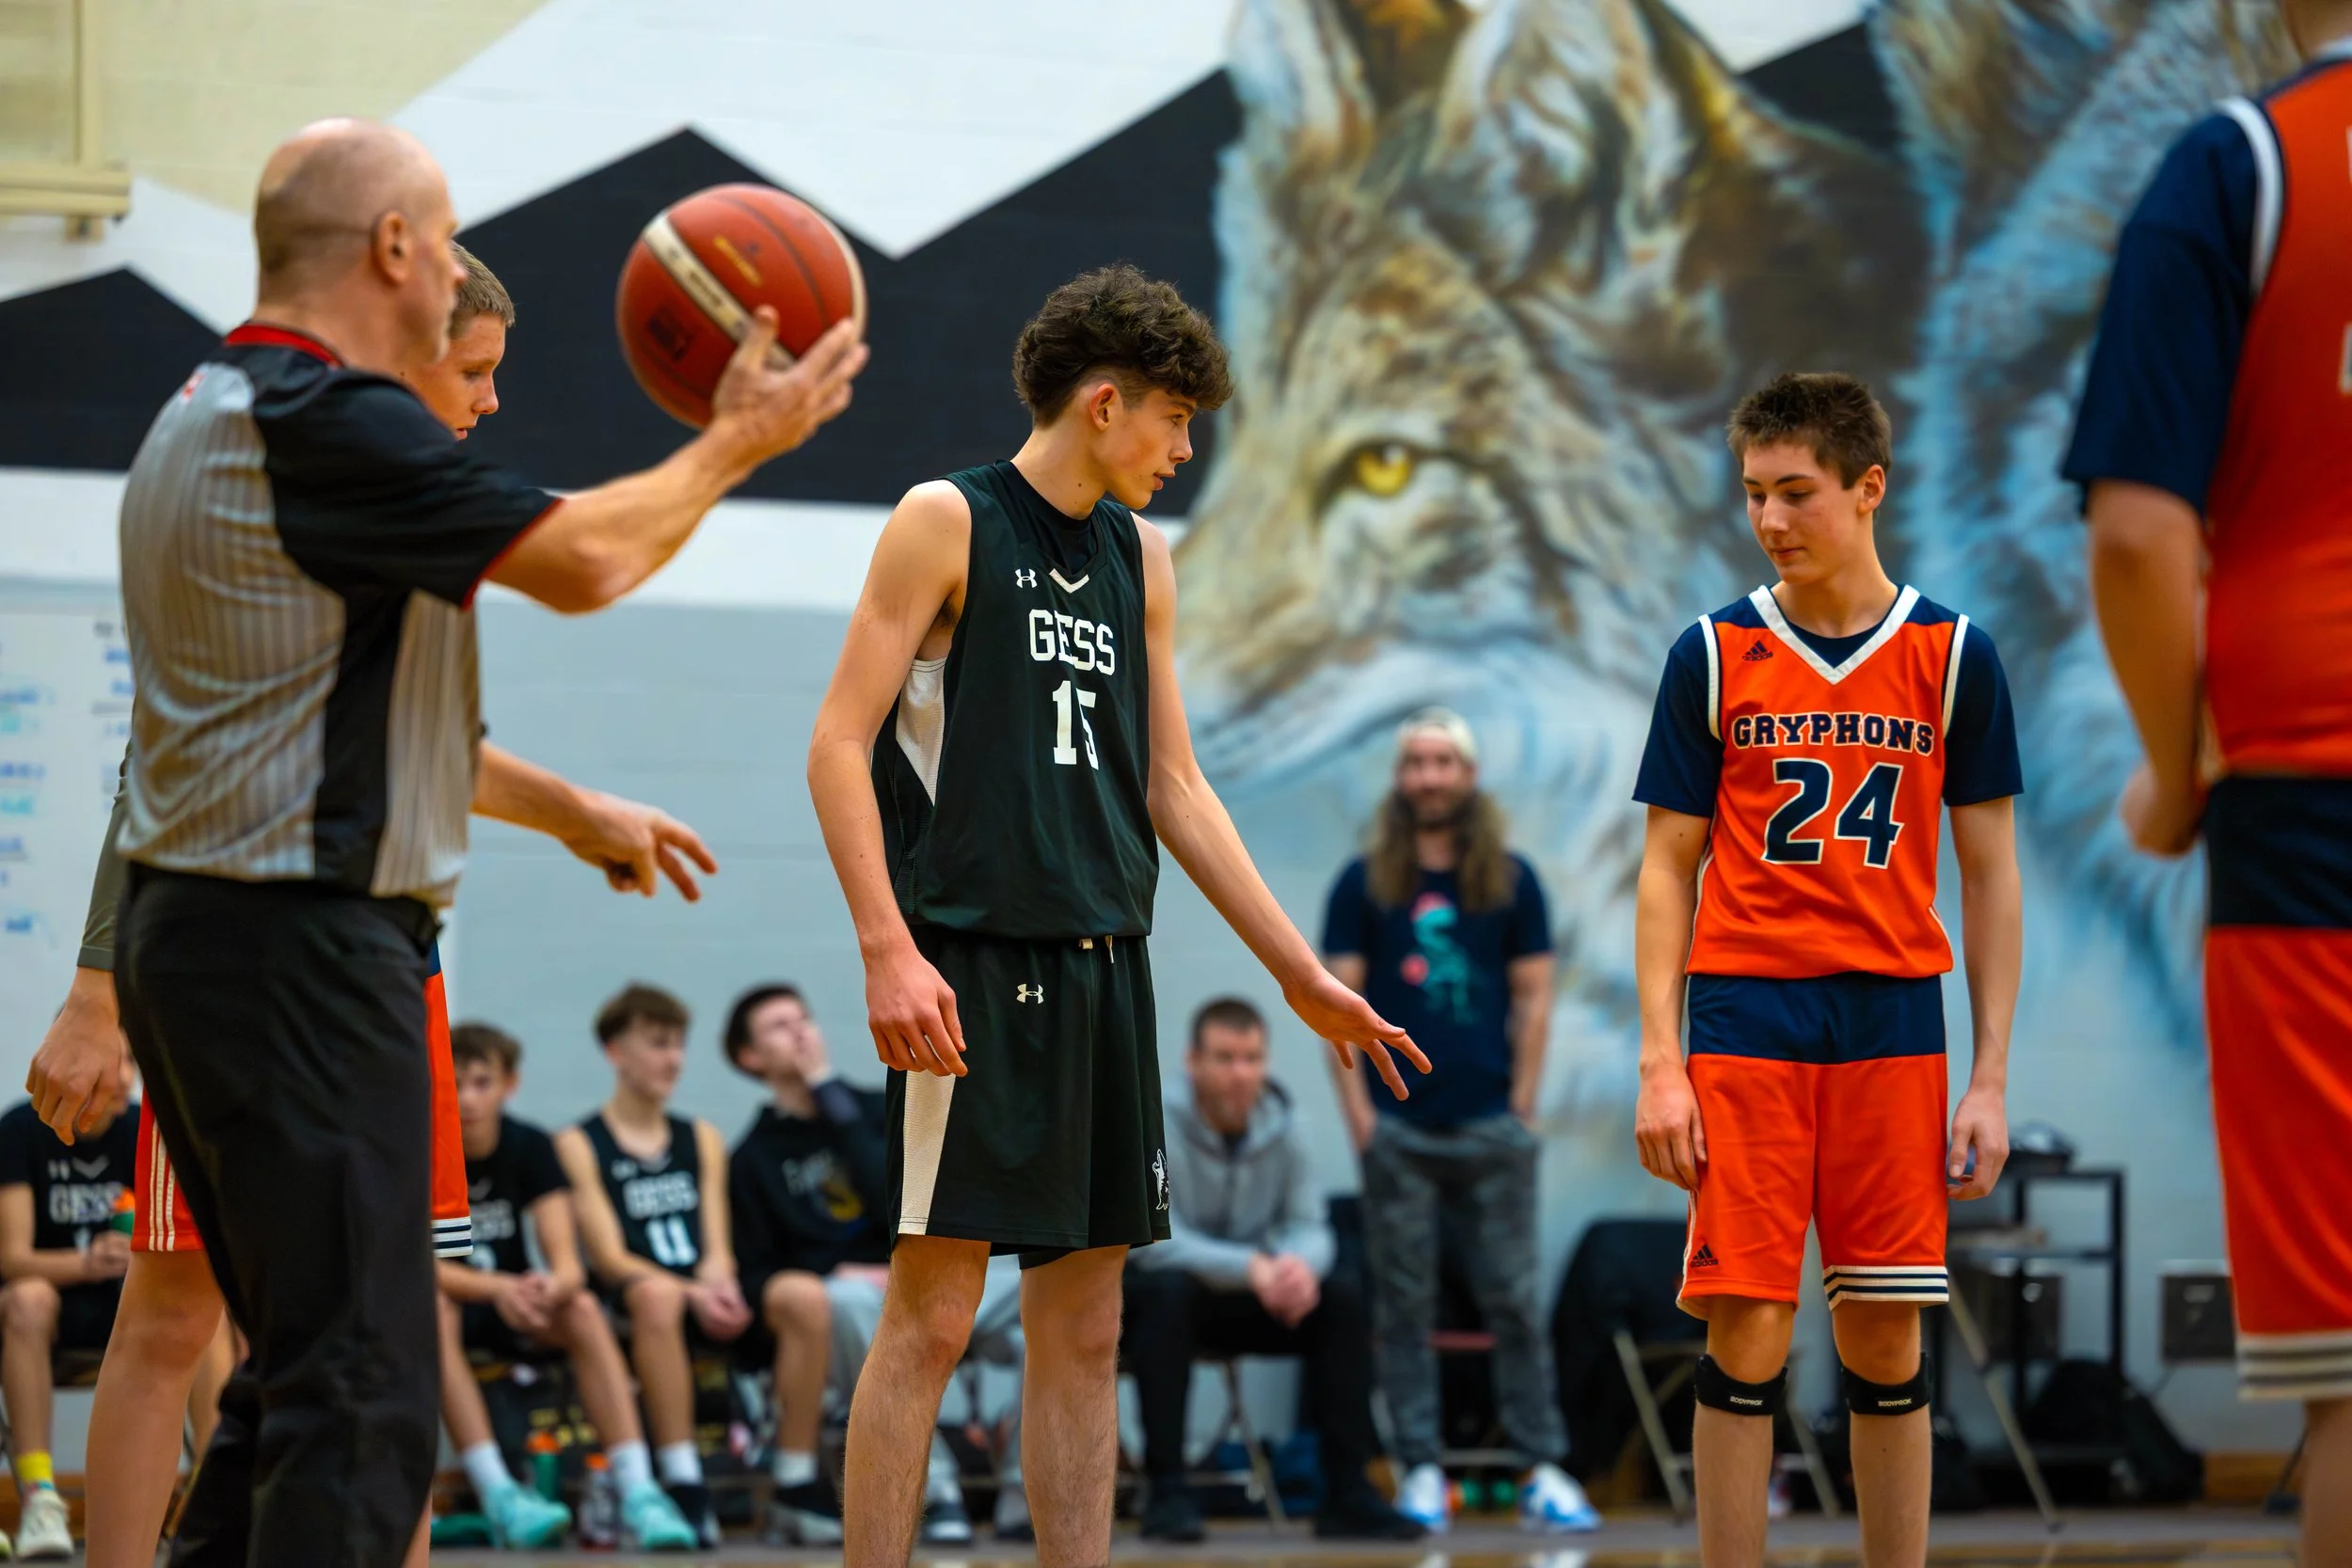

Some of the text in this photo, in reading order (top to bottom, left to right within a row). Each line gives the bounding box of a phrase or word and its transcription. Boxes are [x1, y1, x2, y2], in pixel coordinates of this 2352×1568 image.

[1028, 609, 1117, 676] GESS
[1052, 680, 1100, 770] 15
[1732, 711, 1934, 756] GRYPHONS
[1760, 757, 1904, 869] 24
